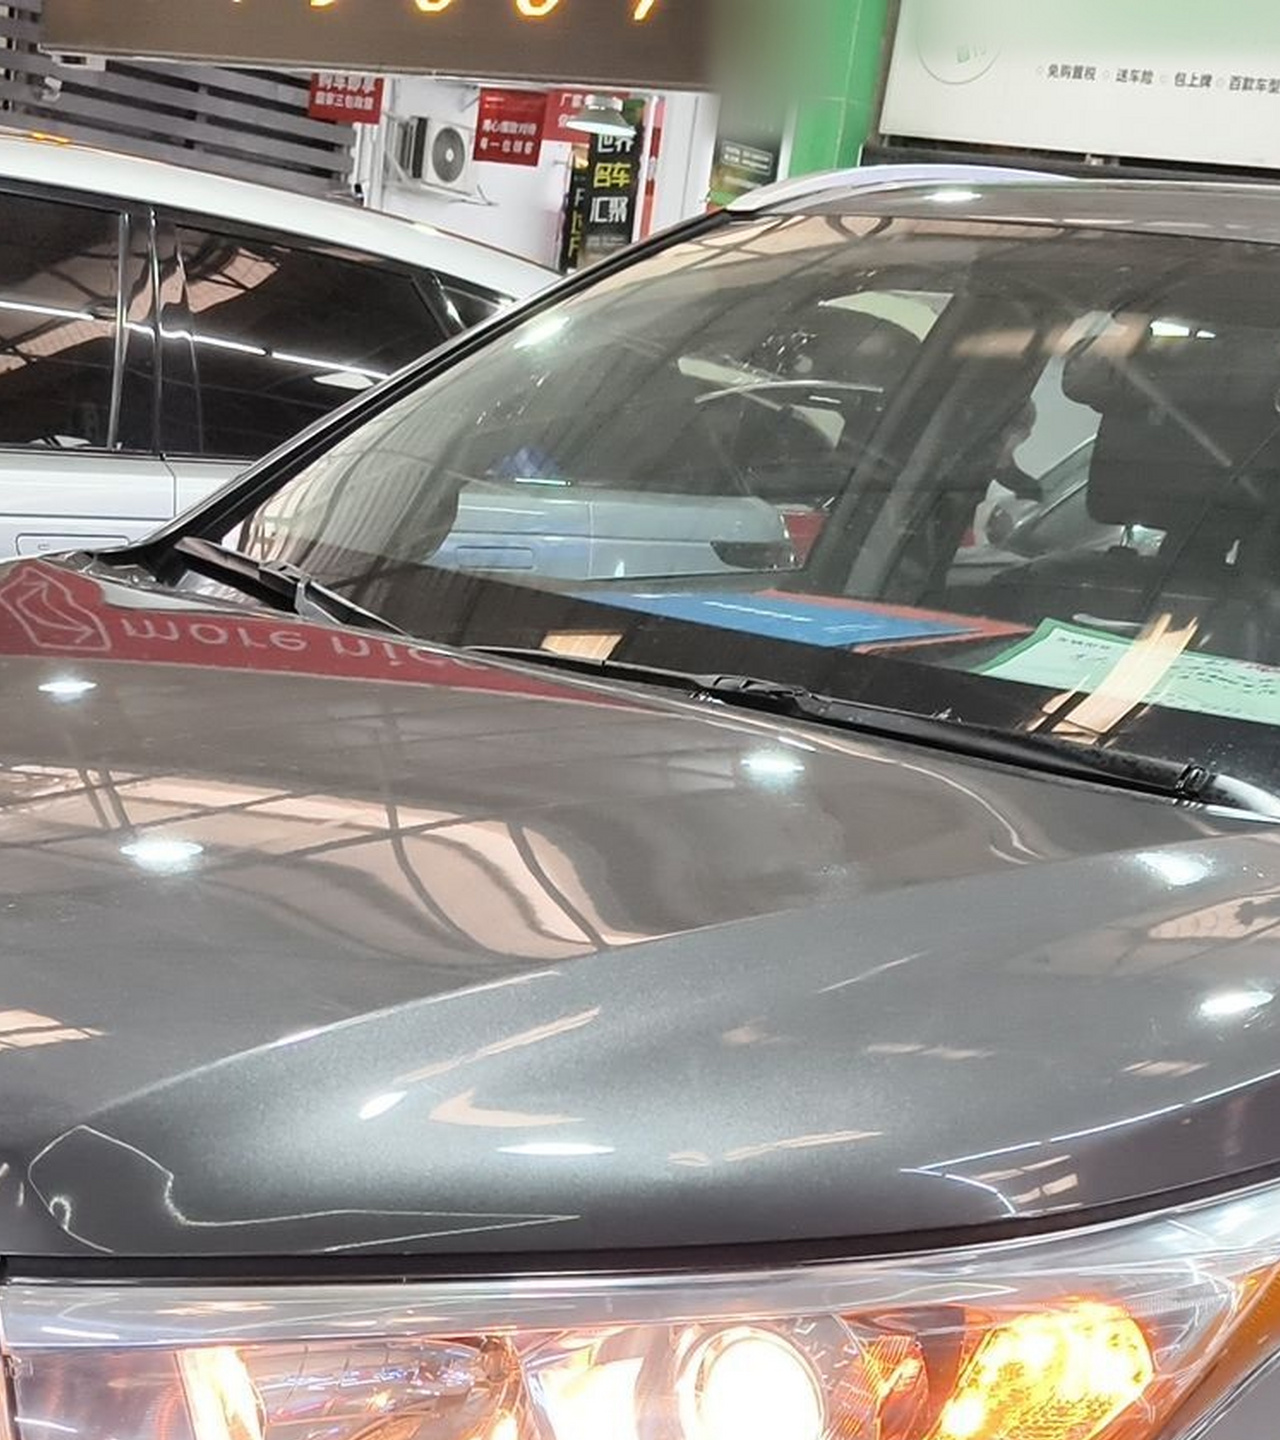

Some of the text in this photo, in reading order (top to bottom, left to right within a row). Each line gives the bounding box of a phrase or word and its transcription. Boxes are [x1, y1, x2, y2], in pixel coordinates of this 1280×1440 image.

[1047, 63, 1097, 81] 免购置税
[1115, 68, 1154, 85] 送车险
[1174, 71, 1213, 88] 包上牌
[593, 162, 632, 189] 名车
[589, 195, 629, 224] 汇聚
